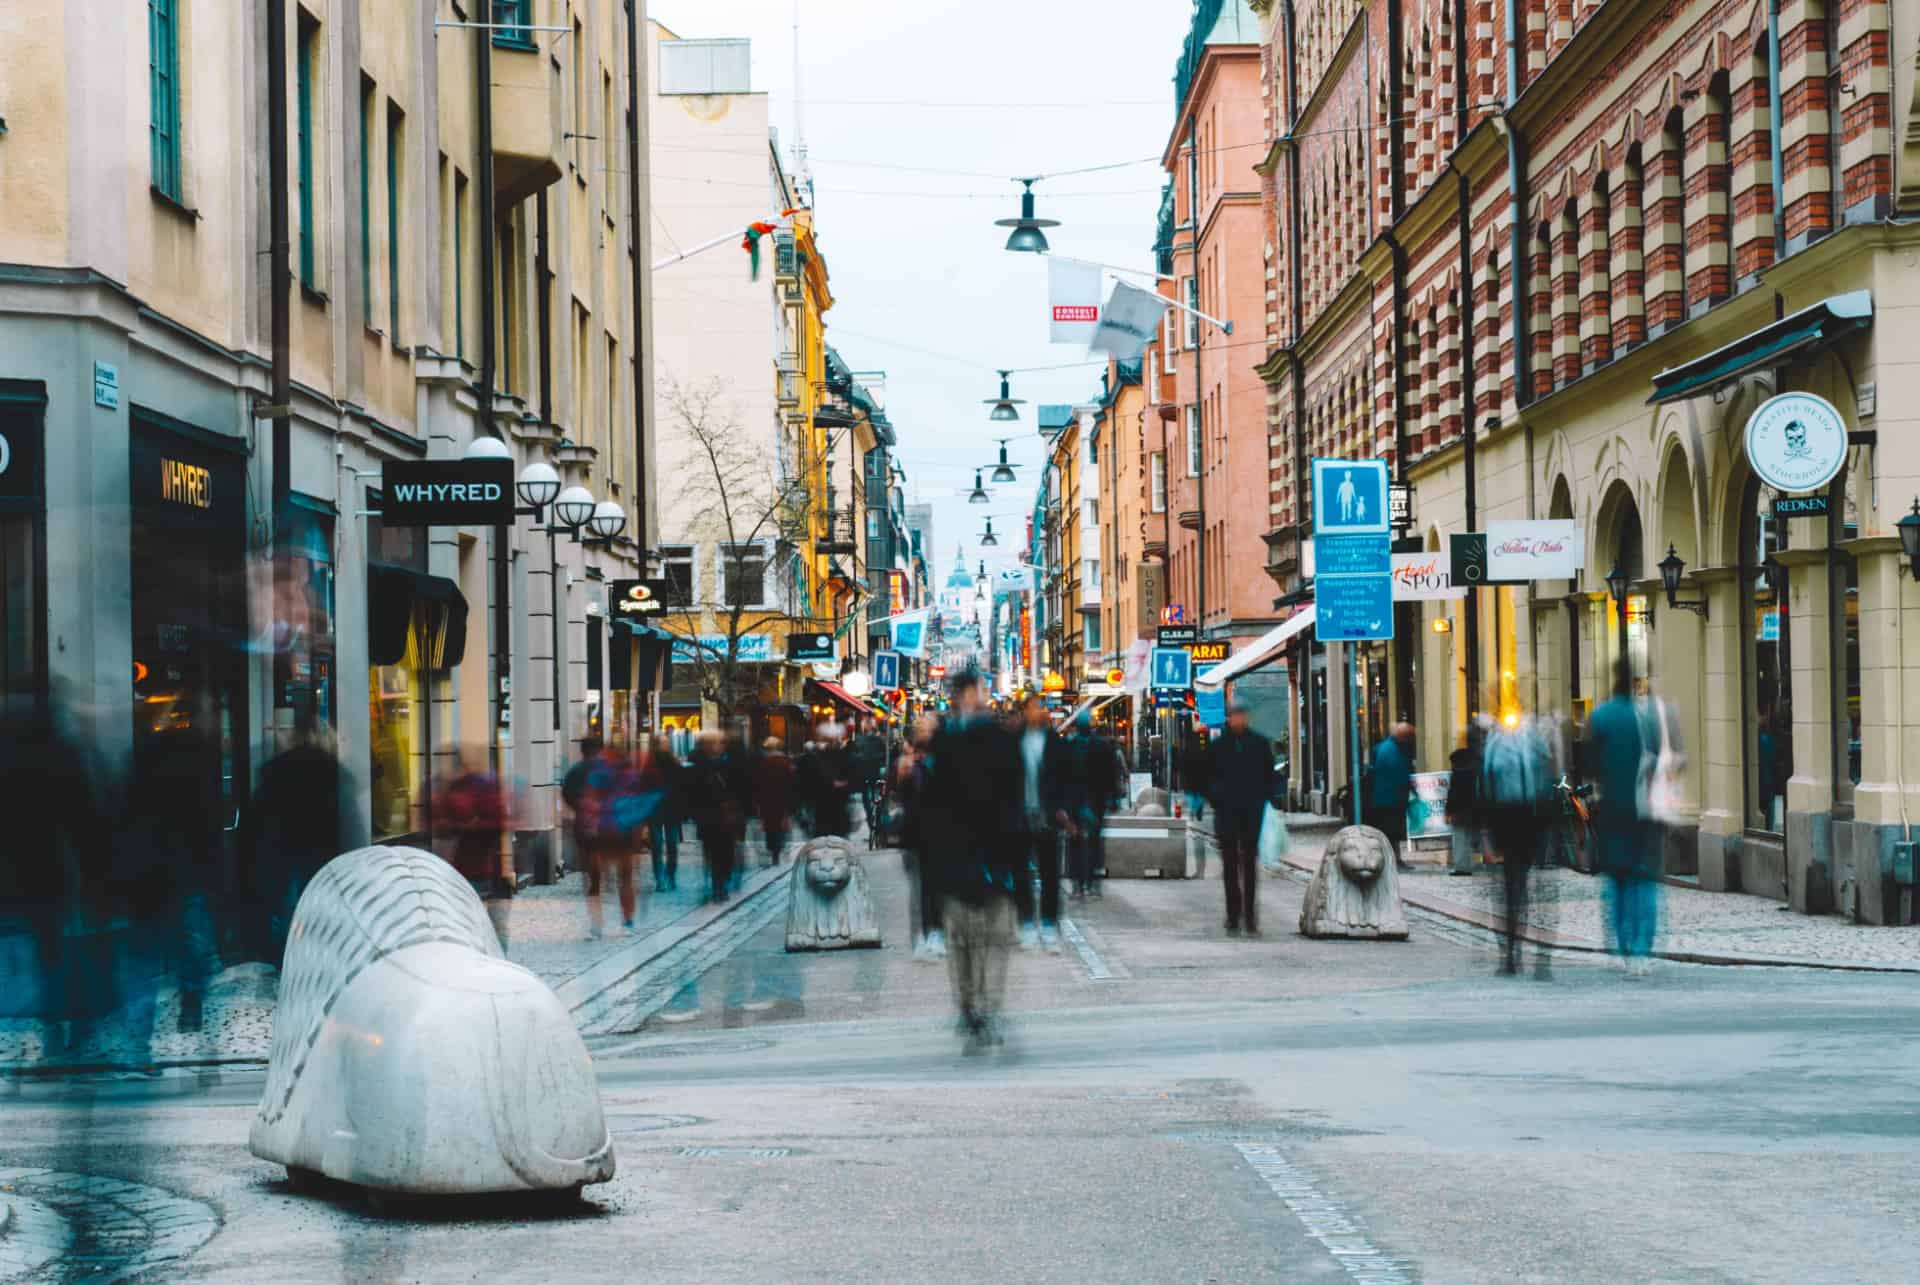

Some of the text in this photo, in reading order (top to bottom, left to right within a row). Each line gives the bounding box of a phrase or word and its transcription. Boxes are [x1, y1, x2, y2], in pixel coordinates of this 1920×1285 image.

[161, 457, 212, 508] WHYRED
[394, 483, 501, 502] WHYRED
[1776, 498, 1827, 512] REDKEN
[1401, 572, 1450, 590] SPOT
